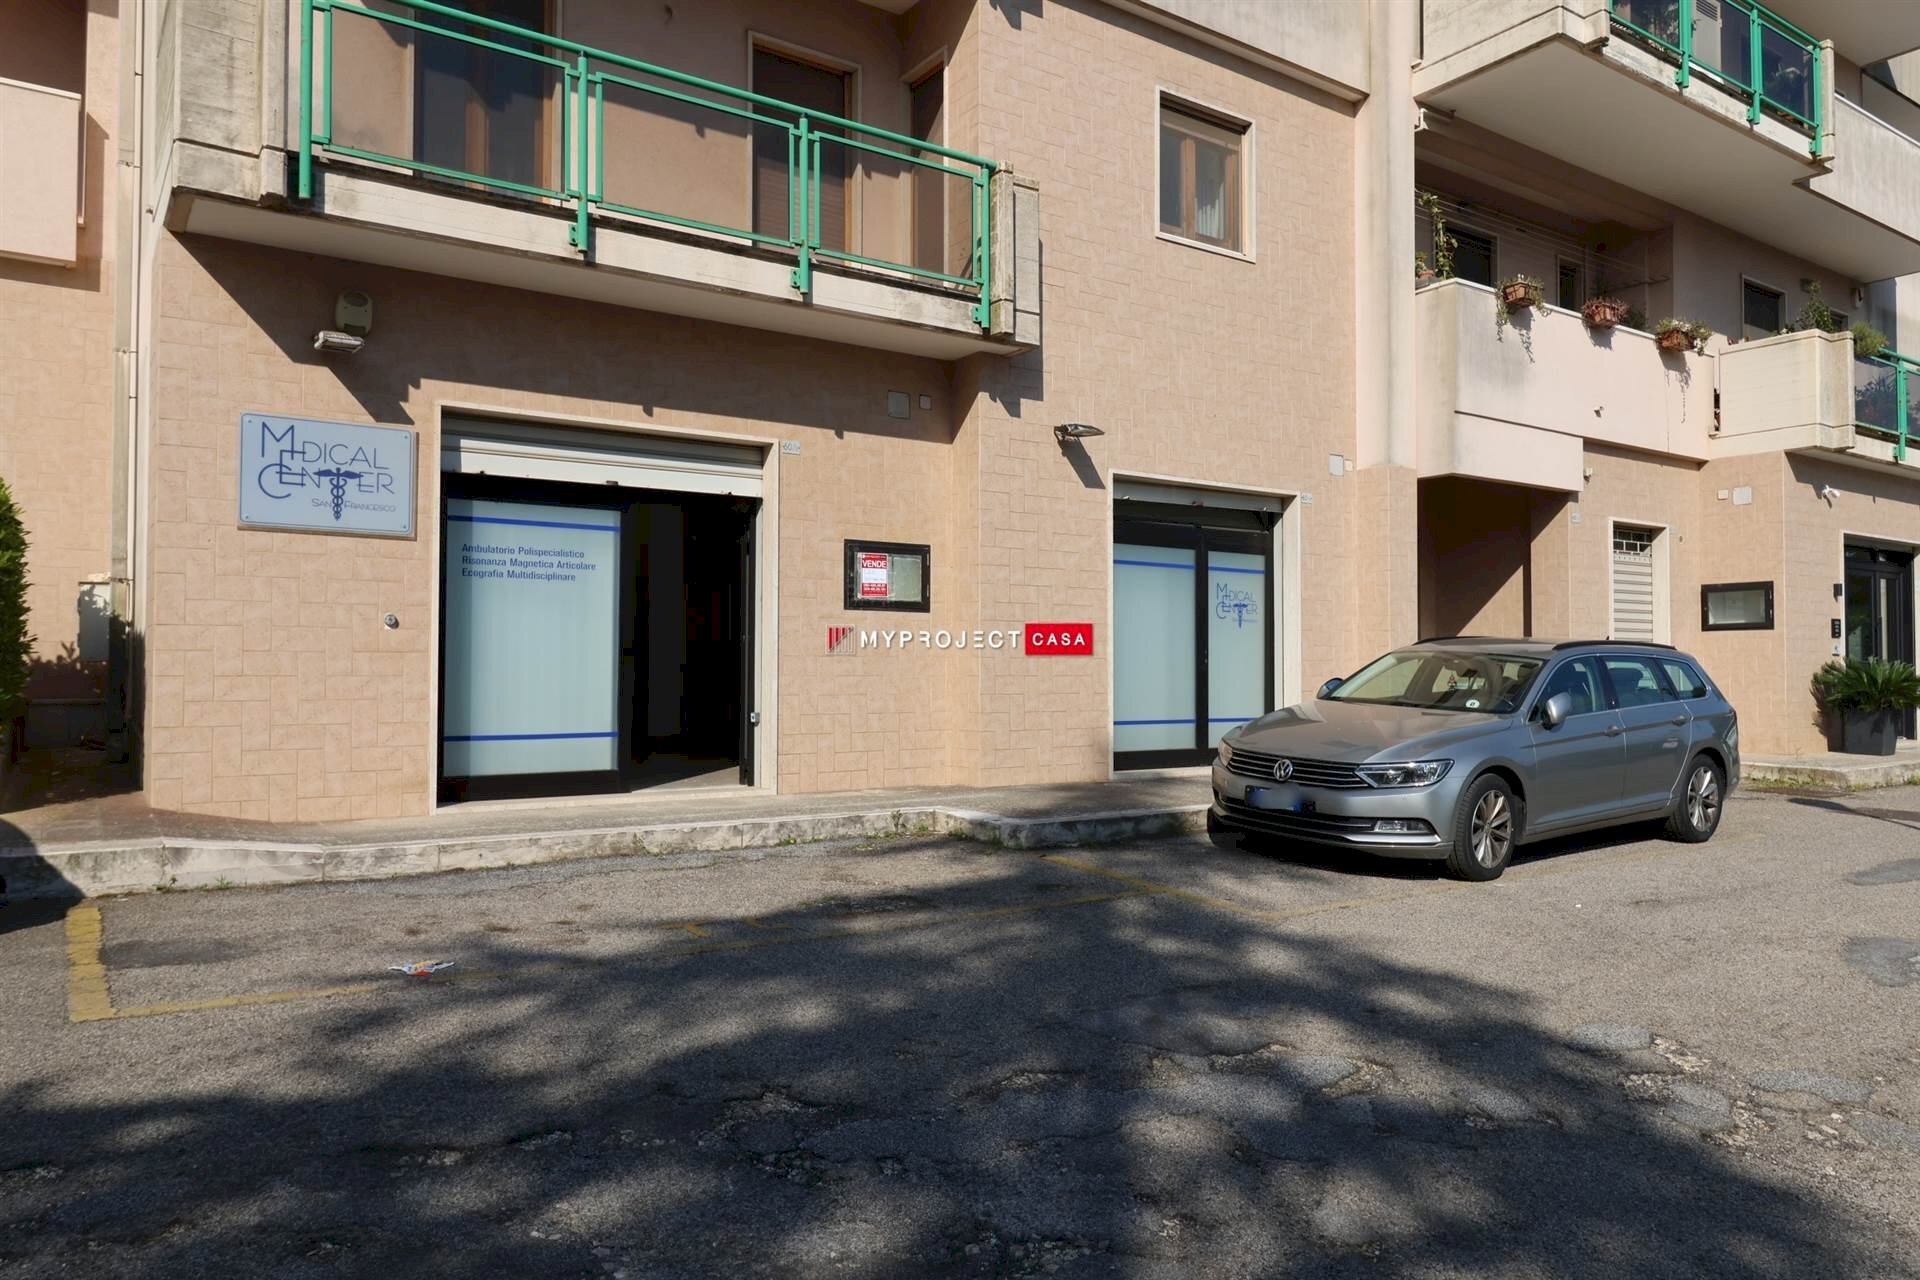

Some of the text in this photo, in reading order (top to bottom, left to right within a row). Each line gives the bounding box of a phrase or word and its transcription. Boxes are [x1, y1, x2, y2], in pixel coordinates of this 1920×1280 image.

[462, 544, 585, 559] Ambulatorio Polispecialistico
[462, 555, 597, 571] Risonanza Magnetica Articolare
[862, 559, 888, 568] VENDE
[462, 568, 577, 582] Ecografia Multidisciplinare
